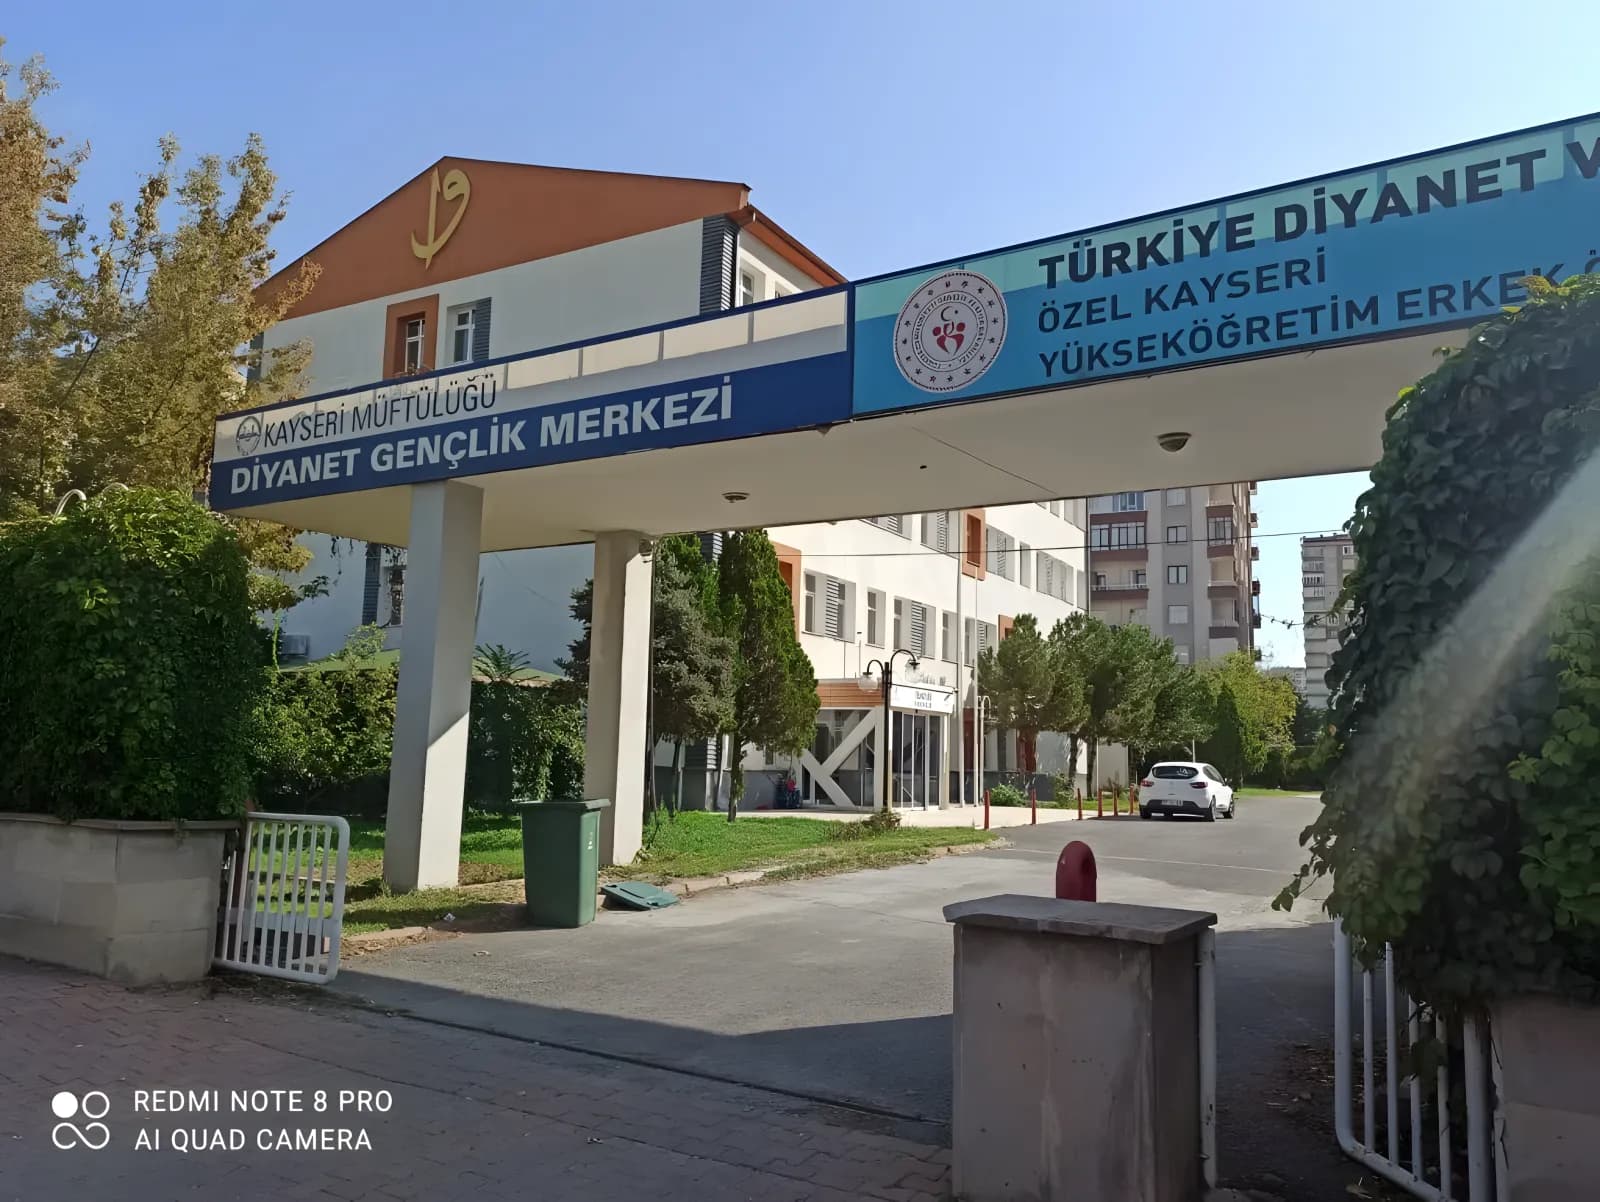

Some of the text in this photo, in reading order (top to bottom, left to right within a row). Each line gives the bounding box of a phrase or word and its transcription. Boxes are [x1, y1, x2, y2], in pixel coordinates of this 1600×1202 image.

[1038, 212, 1256, 290] TÜRKİYE
[1274, 148, 1547, 243] DİYANET
[1038, 294, 1132, 334] ÖZEL
[1144, 246, 1326, 315] KAYSERİ
[1038, 295, 1380, 379] YÜKSEKÖĞRETİM
[231, 375, 733, 495] DİYANET GENÇLİK MERKEZİ
[264, 373, 497, 448] KAYSERİ MÜFTÜLÜĞÜ
